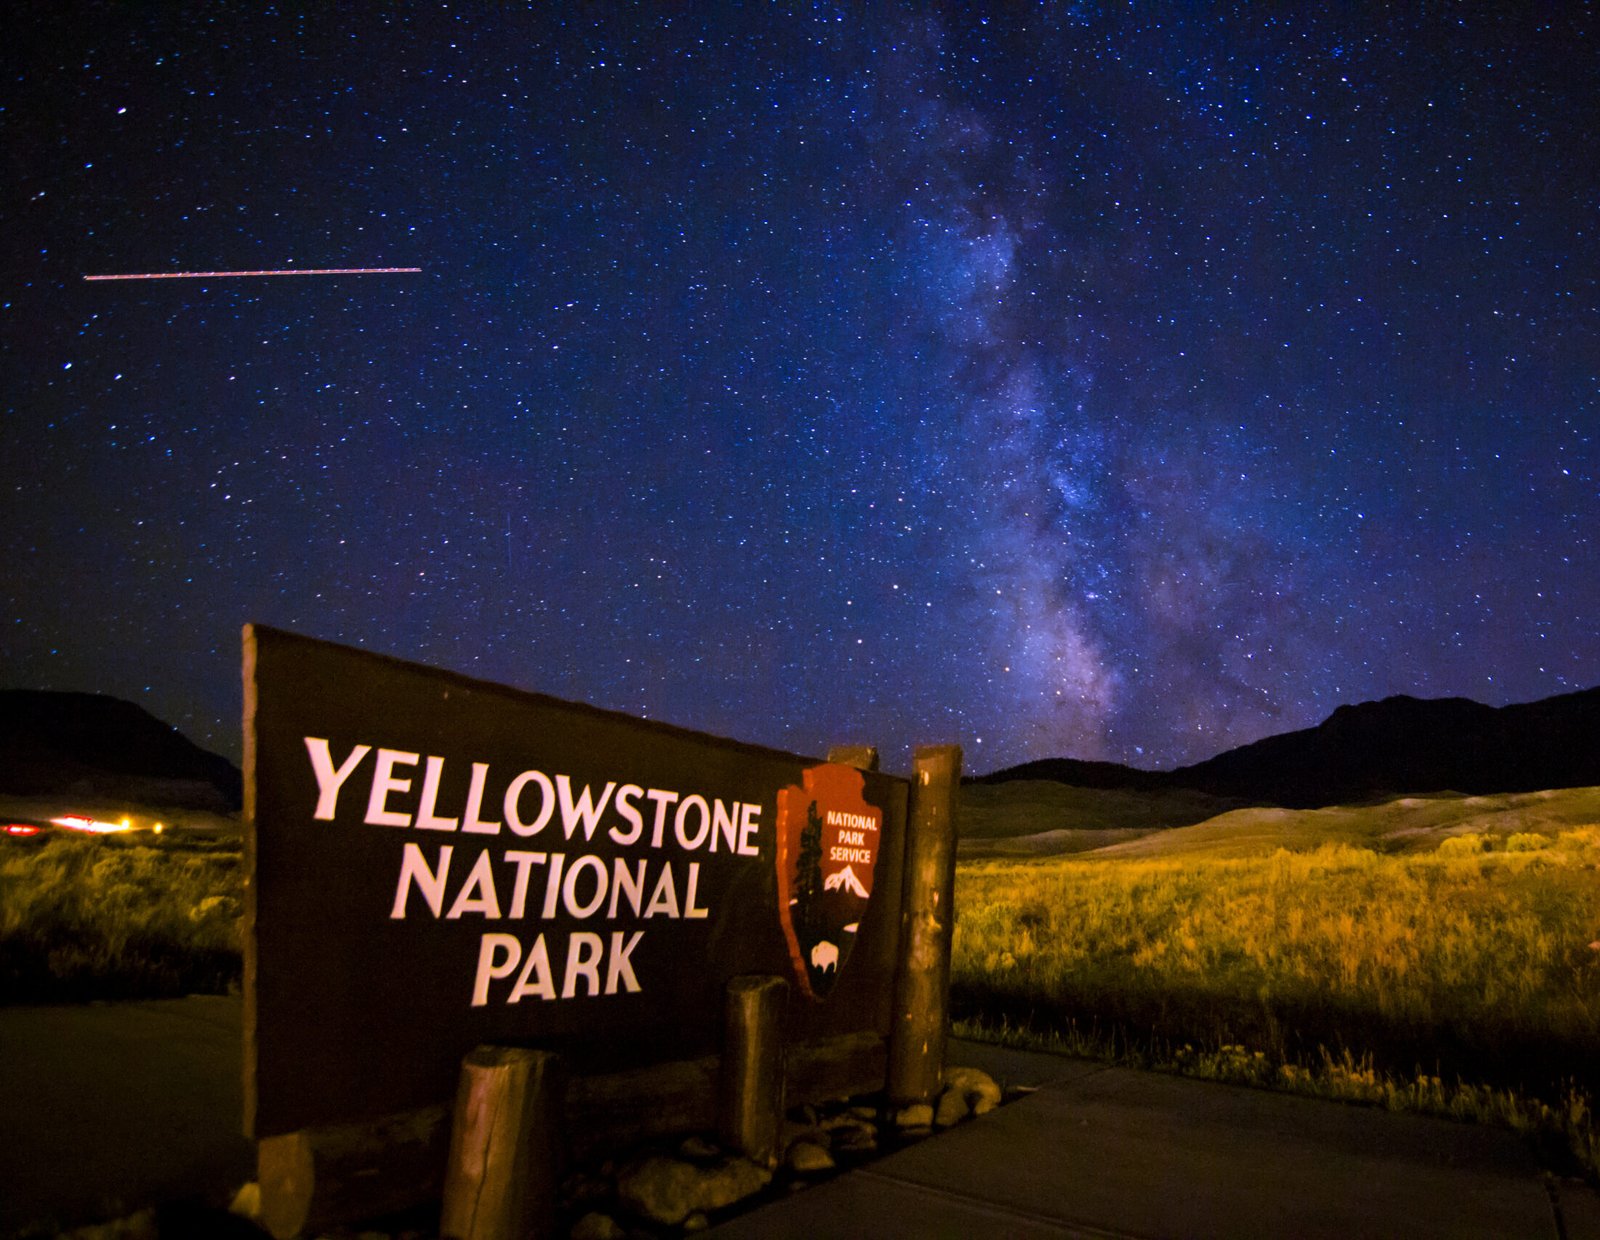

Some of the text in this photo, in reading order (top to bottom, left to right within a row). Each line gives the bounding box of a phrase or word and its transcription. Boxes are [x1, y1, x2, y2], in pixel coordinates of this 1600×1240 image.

[304, 737, 762, 856] YELLOWSTONE
[827, 811, 878, 831] NATIONAL
[838, 830, 865, 846] PARK
[830, 846, 871, 864] SERVICE
[391, 843, 709, 919] NATIONAL
[472, 932, 645, 1006] PARK
